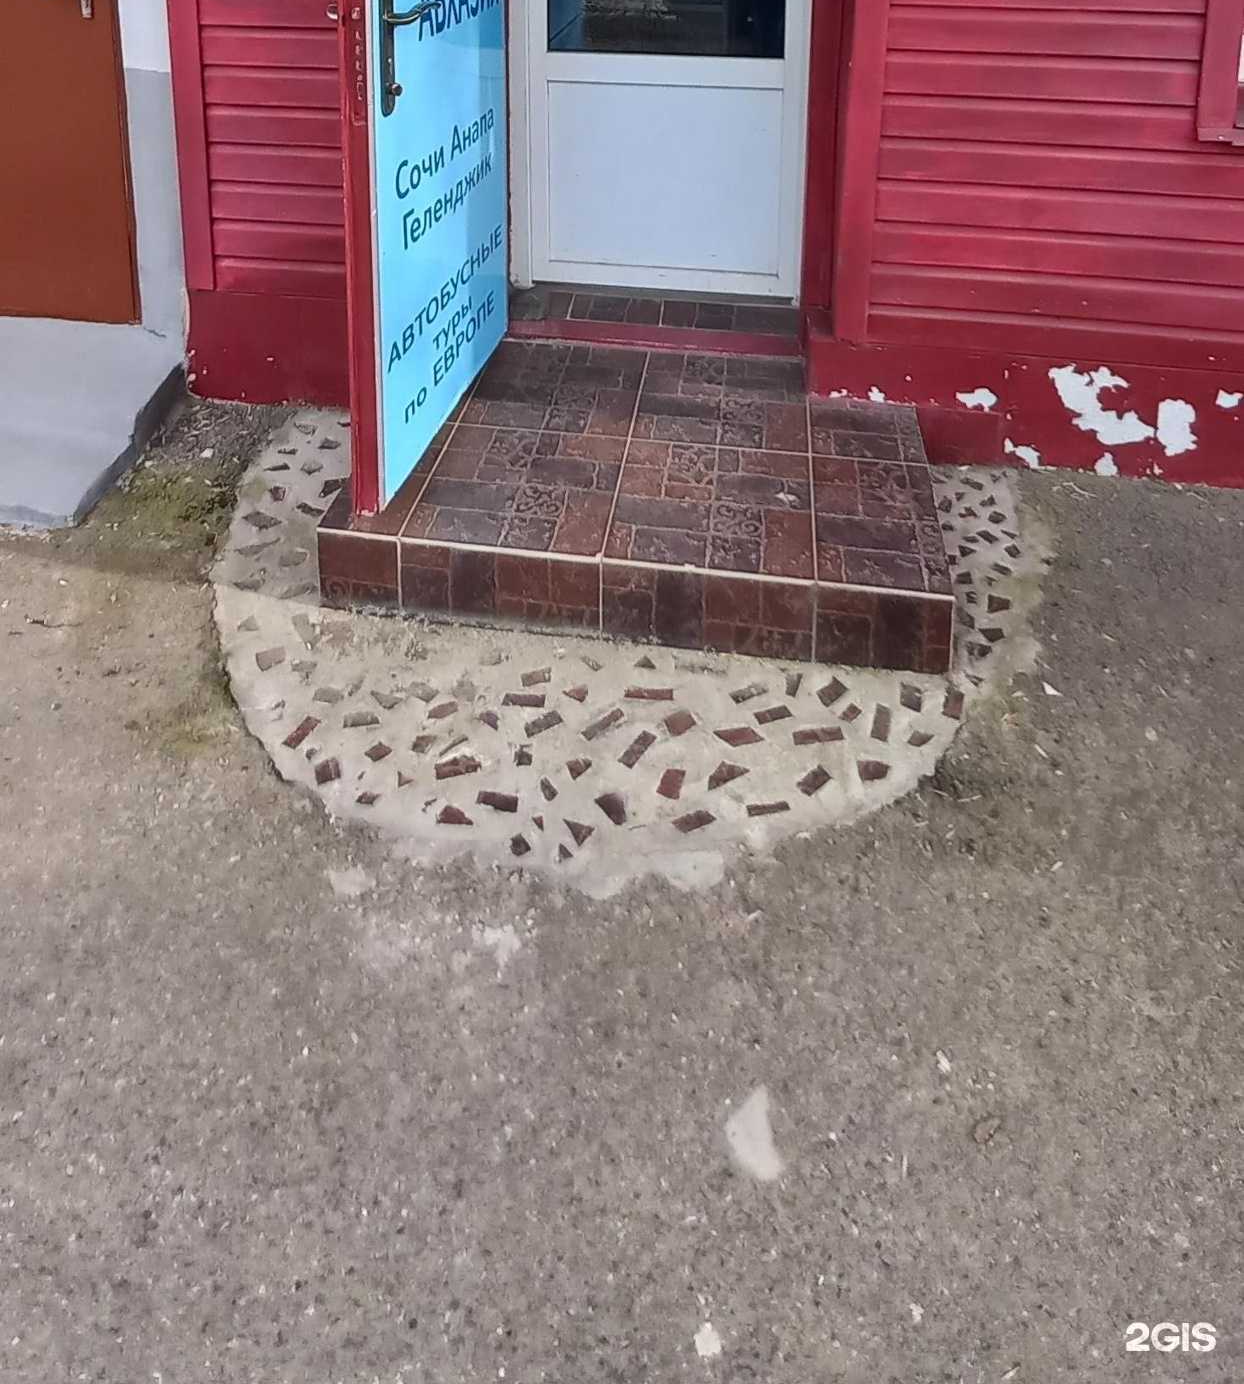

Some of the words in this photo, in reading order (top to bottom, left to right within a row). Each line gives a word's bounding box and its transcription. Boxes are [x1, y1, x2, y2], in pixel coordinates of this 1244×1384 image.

[395, 145, 445, 199] Сочи
[450, 108, 494, 161] Анапа
[402, 152, 492, 250] Геленджик
[388, 224, 503, 373] АВТОБУСНЫЕ
[433, 295, 473, 351] туры
[405, 386, 427, 424] по
[433, 290, 495, 387] ЕВРОПЕ
